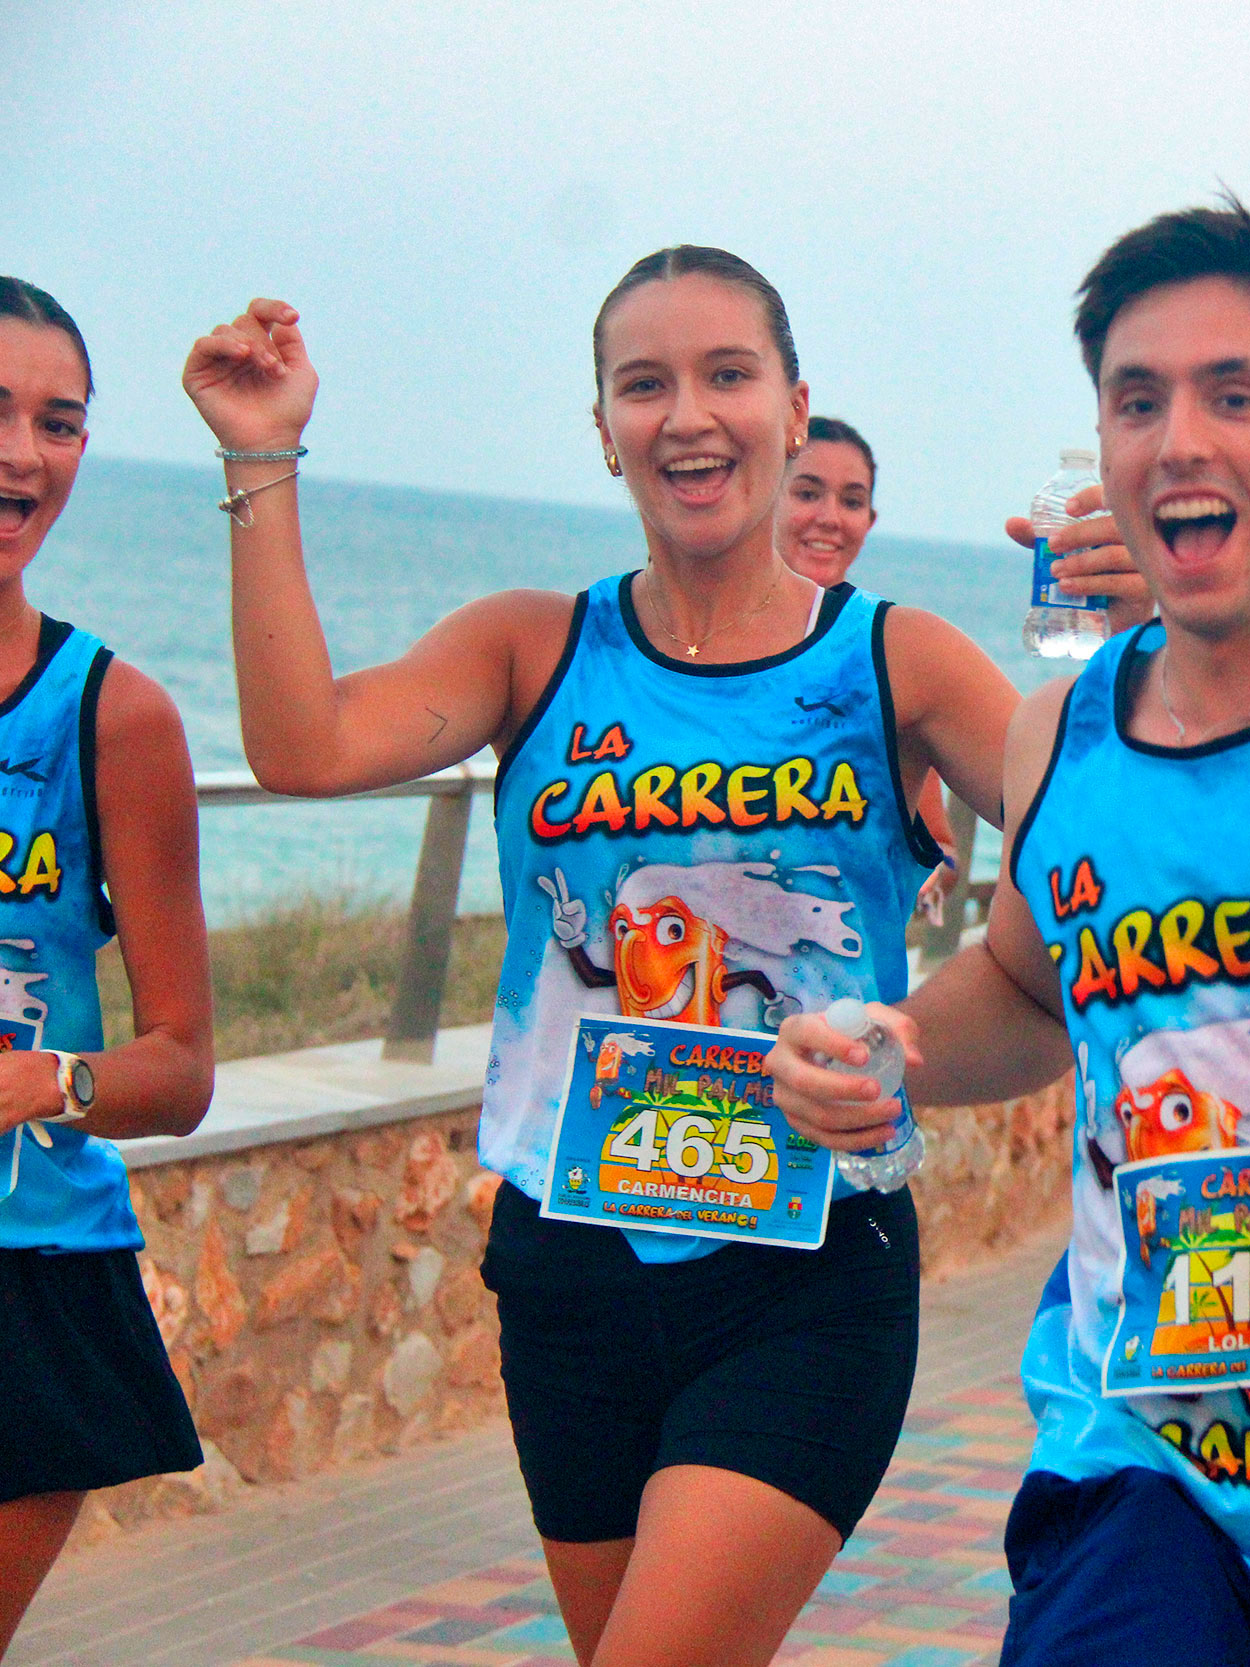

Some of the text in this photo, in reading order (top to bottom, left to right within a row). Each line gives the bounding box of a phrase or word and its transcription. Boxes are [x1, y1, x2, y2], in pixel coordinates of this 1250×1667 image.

[570, 725, 631, 762] LA
[530, 757, 869, 839] CARRERA
[1051, 861, 1100, 917] LA
[643, 1068, 683, 1097] MIL
[608, 1109, 773, 1184] 465
[603, 1201, 617, 1213] LA
[619, 1203, 673, 1219] CARRERA
[676, 1209, 693, 1221] DEL
[617, 1179, 754, 1210] CARMENCITA
[1178, 1206, 1219, 1236] MIL
